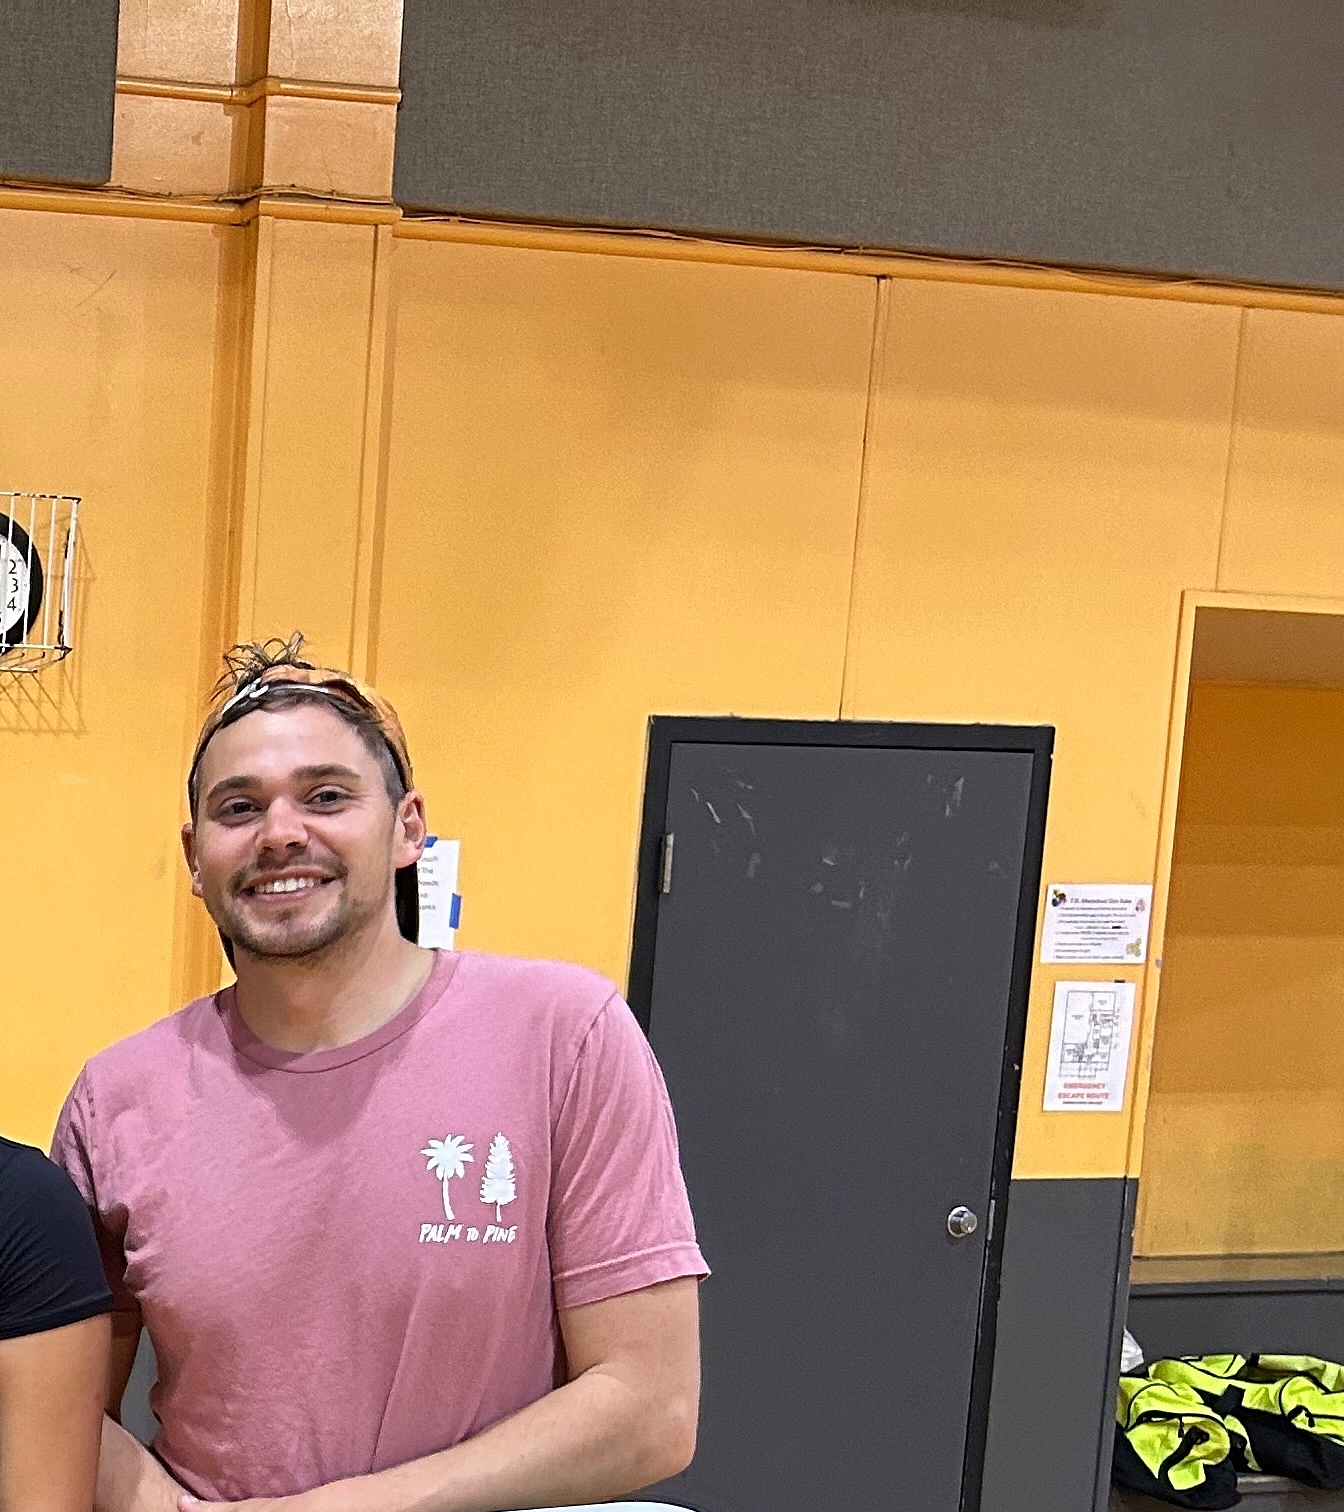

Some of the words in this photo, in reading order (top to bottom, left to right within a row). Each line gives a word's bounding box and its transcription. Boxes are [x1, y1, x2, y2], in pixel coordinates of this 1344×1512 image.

[9, 560, 18, 574] 2
[12, 578, 19, 593] 3
[7, 597, 17, 611] 4
[419, 1223, 463, 1243] PALM
